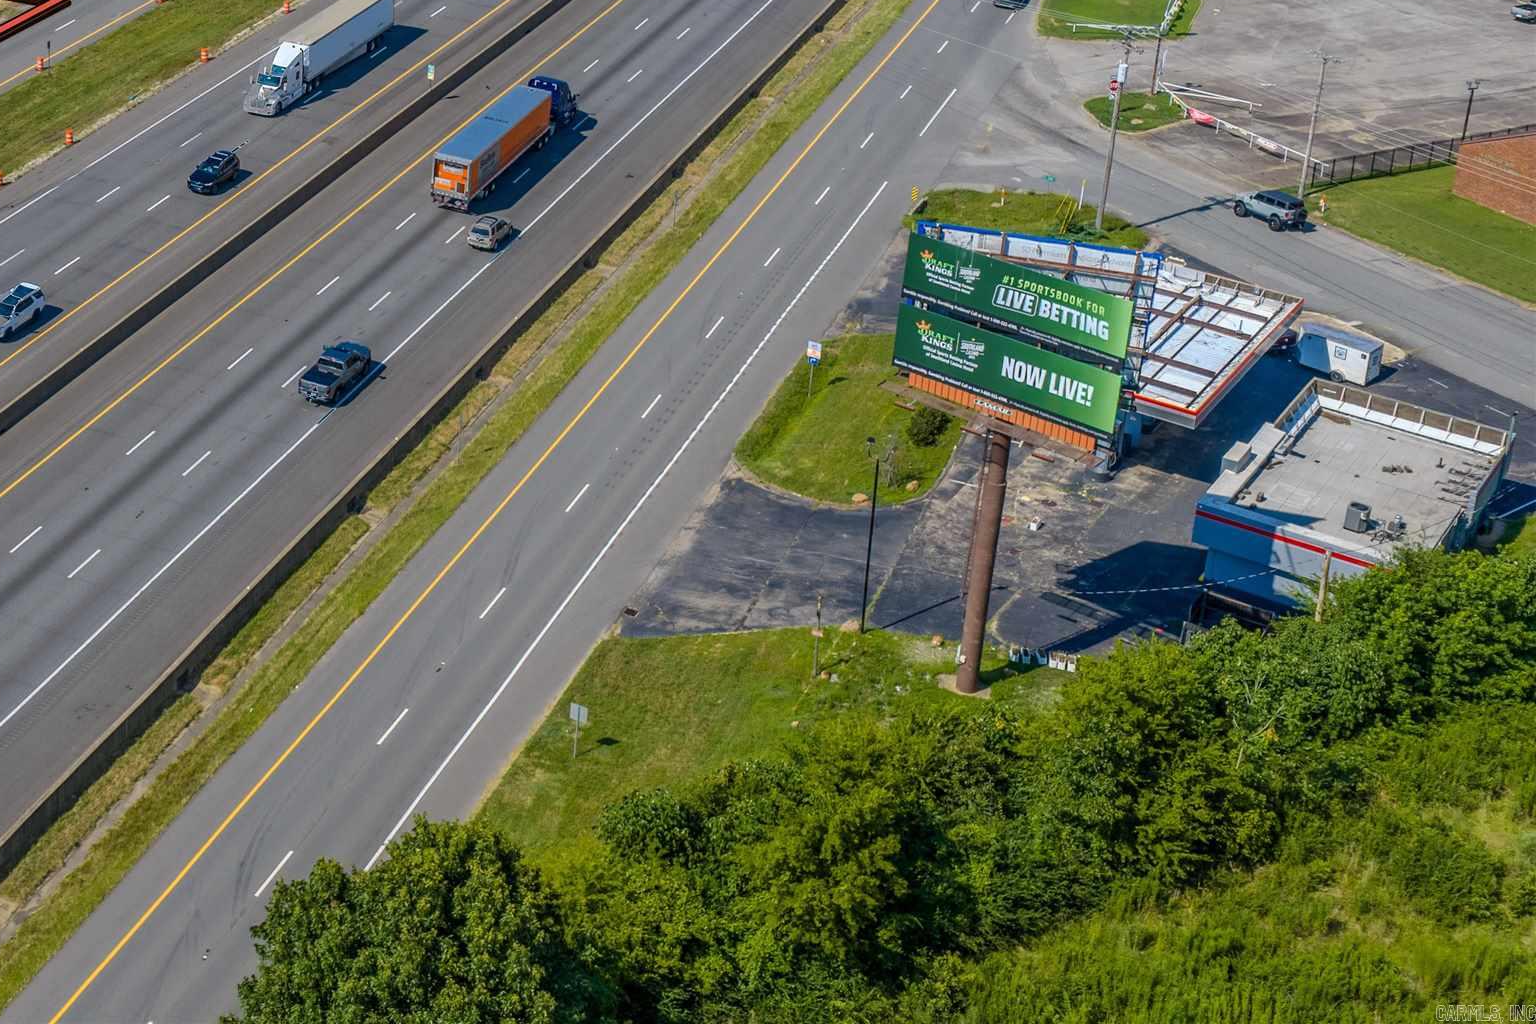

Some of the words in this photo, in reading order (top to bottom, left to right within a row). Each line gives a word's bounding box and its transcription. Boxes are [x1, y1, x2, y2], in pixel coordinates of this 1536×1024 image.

[924, 262, 953, 278] KINGS
[1002, 275, 1014, 286] #1
[1017, 279, 1083, 308] SPORTSBOOK
[1086, 300, 1105, 316] FOR
[995, 287, 1035, 313] LIVE
[1038, 299, 1109, 341] BETTING
[917, 328, 955, 344] DRAFT
[921, 334, 953, 352] KINGS
[1001, 355, 1047, 390] NOW
[1049, 372, 1095, 407] LIVE!
